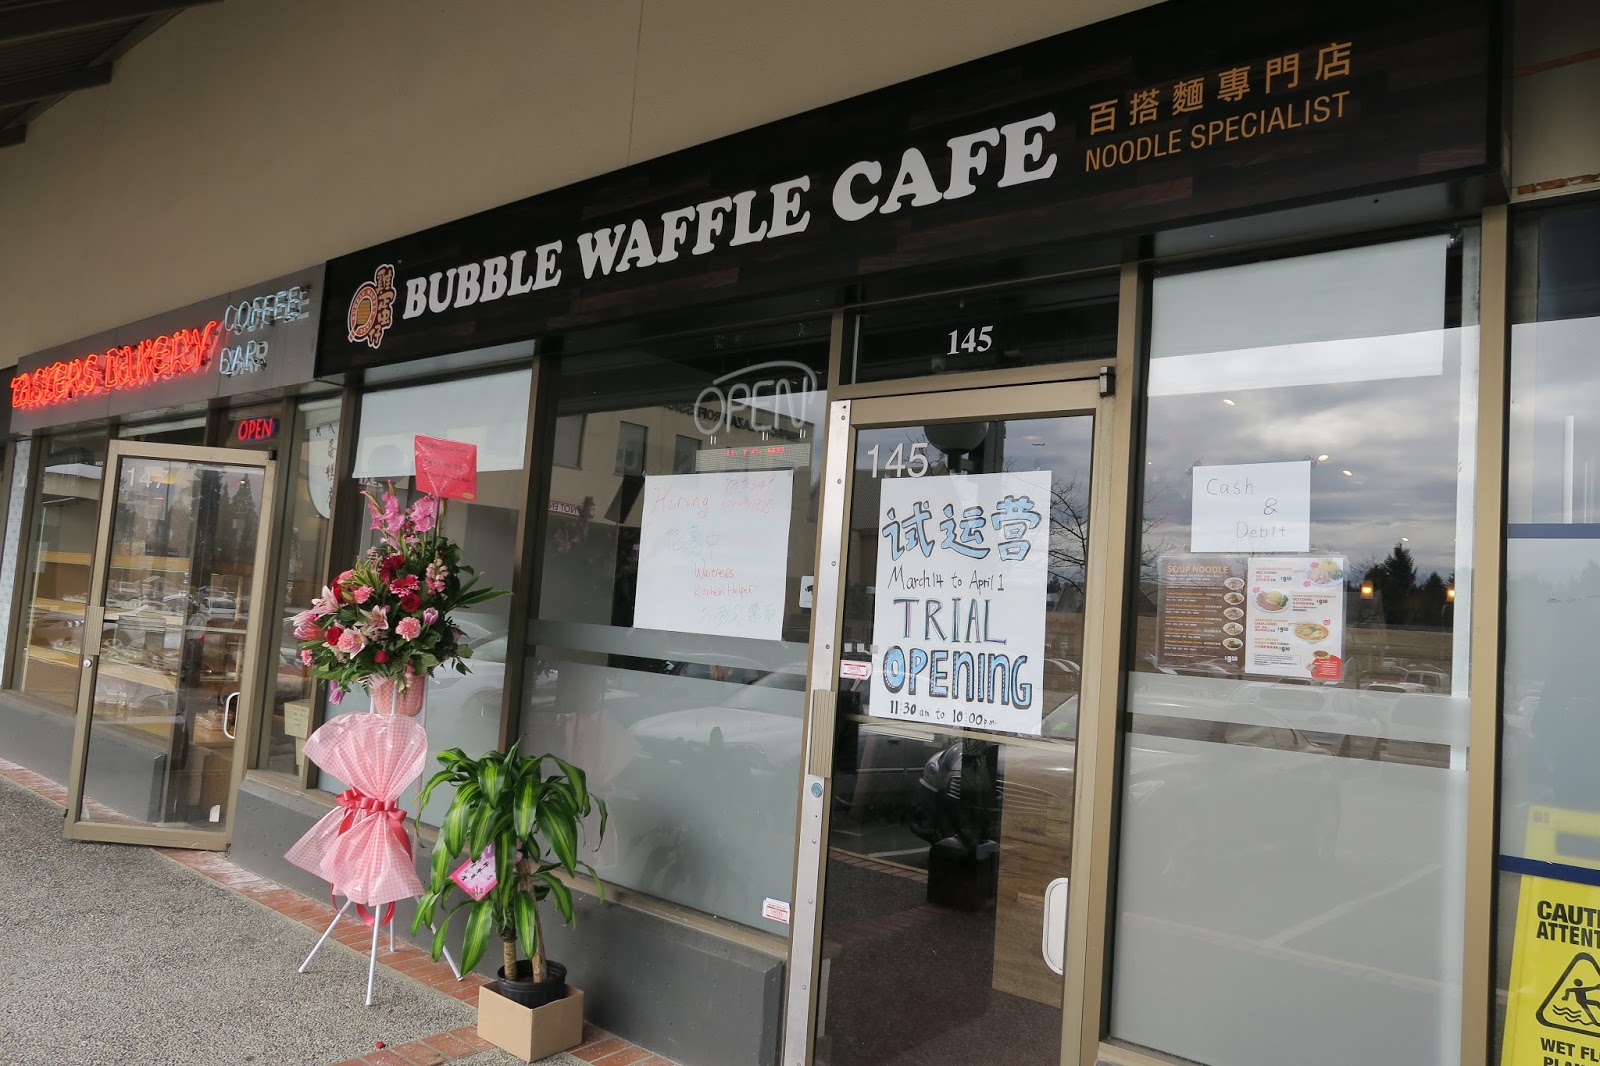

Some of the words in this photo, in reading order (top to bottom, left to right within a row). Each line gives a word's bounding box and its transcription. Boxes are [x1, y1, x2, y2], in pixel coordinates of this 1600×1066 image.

[1088, 41, 1352, 136] 百搭麵專門店
[1085, 128, 1182, 172] NOODLE
[1190, 91, 1350, 149] SPECIALIST
[402, 239, 563, 320] BUBBLE
[576, 175, 811, 280] WAFFLE
[832, 111, 1058, 222] CAFE
[224, 286, 310, 335] COFFEE
[947, 325, 993, 355] 145
[10, 353, 99, 408] TASTERS
[105, 319, 218, 388] BAKERY
[219, 340, 268, 377] BAR
[694, 376, 809, 435] OPEN
[238, 417, 274, 441] OPEN
[867, 443, 930, 478] 145
[127, 466, 169, 489] 147
[1206, 477, 1254, 496] Cash
[1263, 498, 1278, 515] &
[881, 495, 1042, 561] 试运营
[1236, 521, 1286, 538] Debit
[694, 558, 736, 580] Waitress
[951, 571, 963, 588] to
[969, 570, 993, 595] April
[997, 574, 1004, 591] 1
[1167, 565, 1190, 573] SOUP
[1192, 565, 1229, 574] NOODLE
[727, 583, 758, 599] Helper
[893, 597, 1007, 645] TRIAL
[883, 645, 1032, 710] OPENING
[890, 700, 917, 715] 11:30
[935, 708, 945, 719] to
[952, 709, 983, 725] 10:00
[1540, 1037, 1575, 1057] WET
[1580, 1046, 1600, 1063] FL
